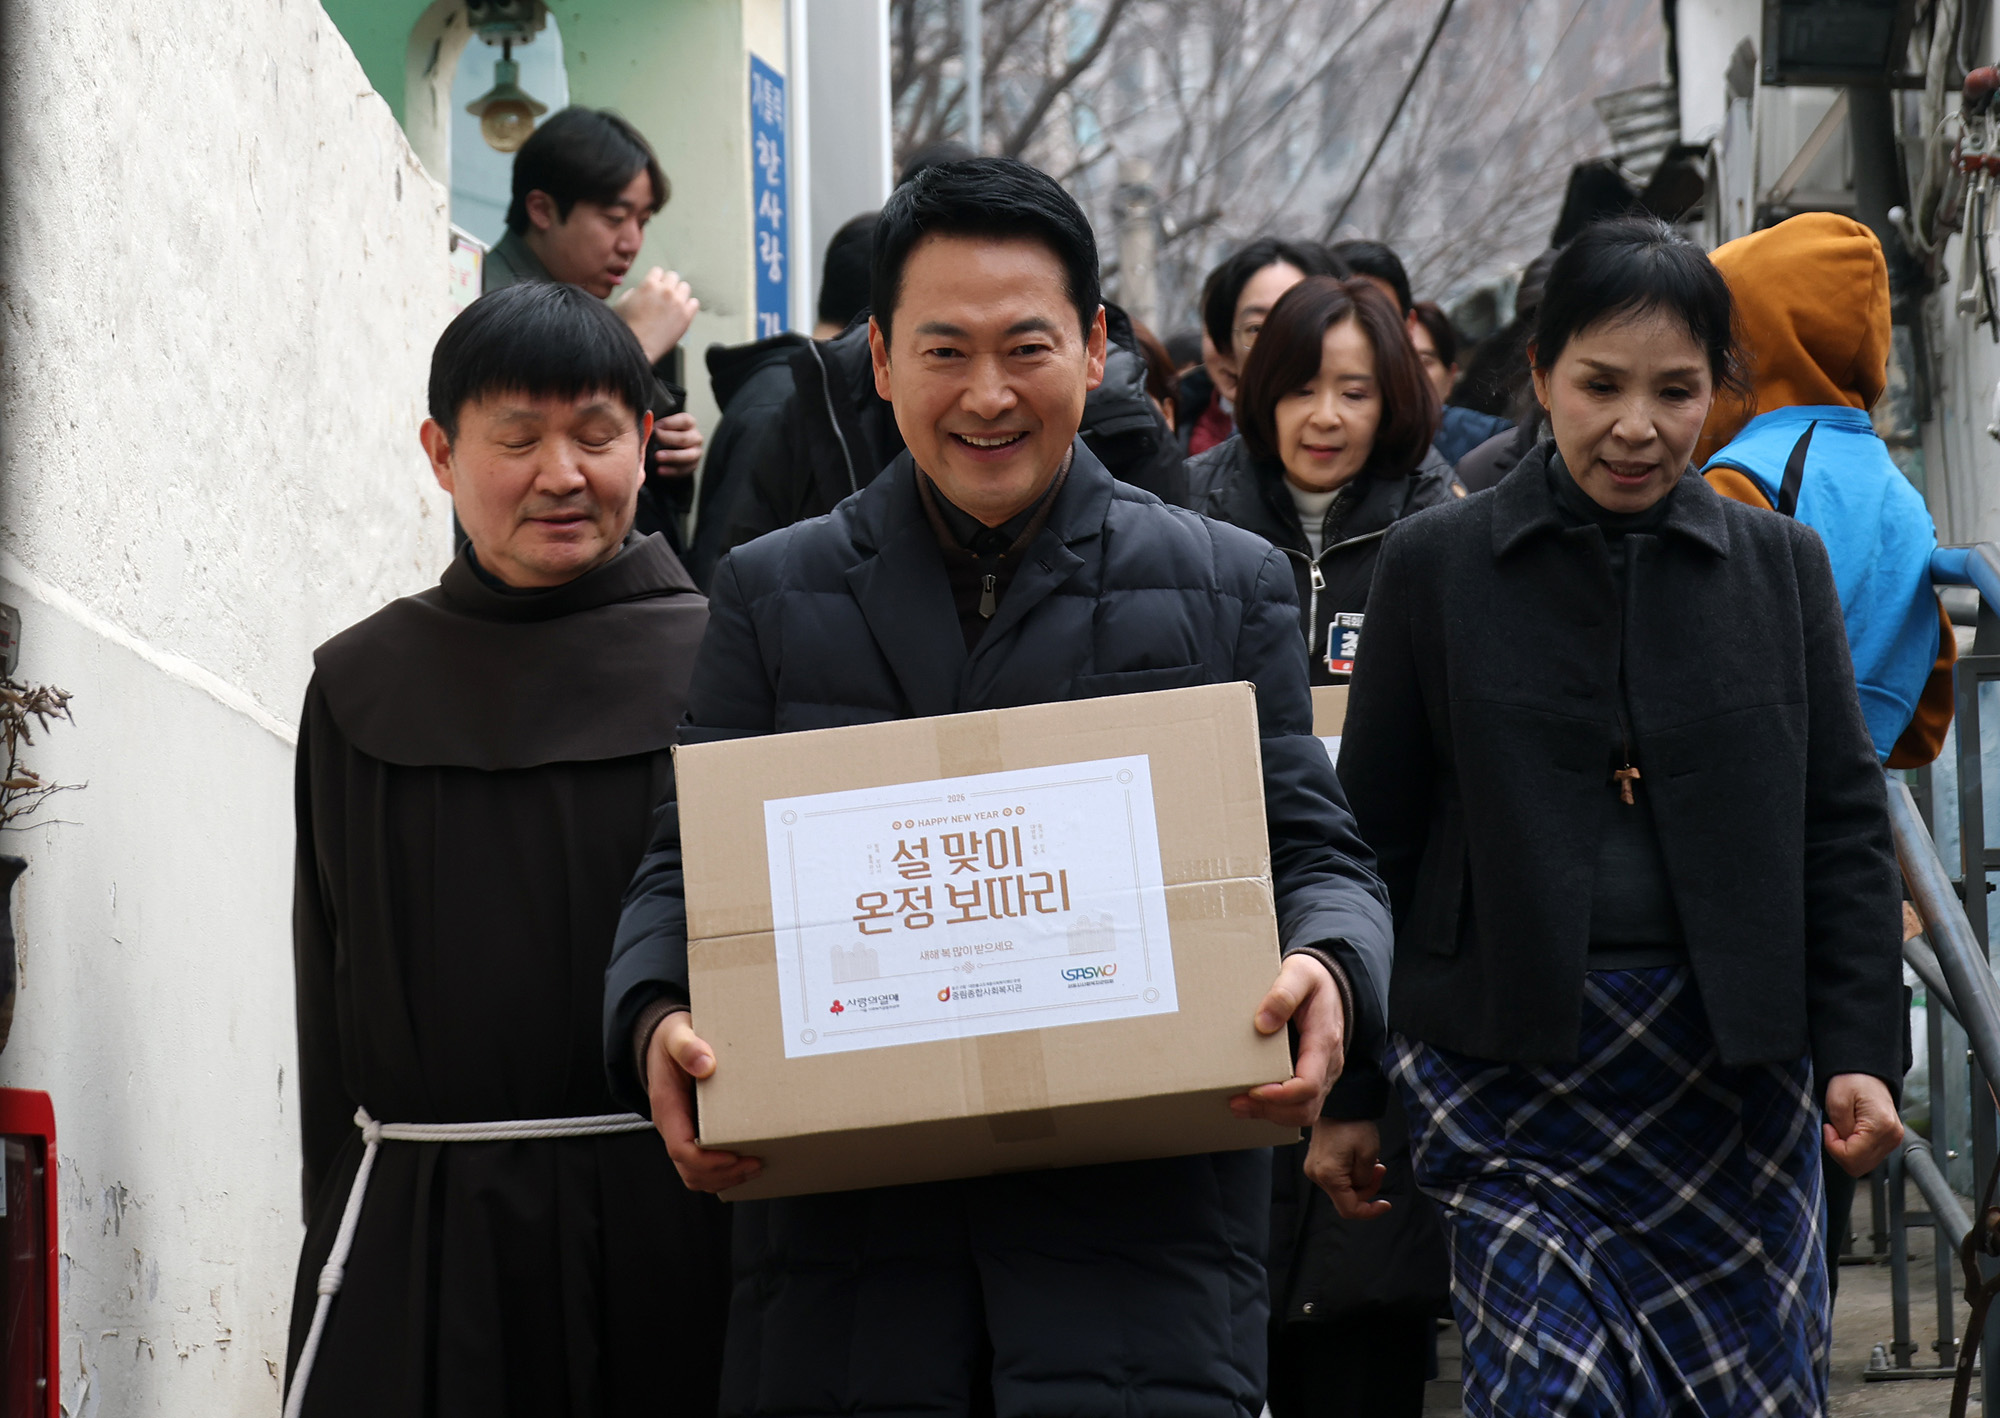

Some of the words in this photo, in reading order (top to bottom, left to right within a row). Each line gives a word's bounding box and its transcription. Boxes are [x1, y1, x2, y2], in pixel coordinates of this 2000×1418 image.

[756, 131, 784, 284] 한사랑
[947, 793, 966, 803] 2026
[918, 816, 949, 828] HAPPY
[951, 813, 972, 824] NEW
[974, 810, 999, 821] YEAR
[891, 836, 933, 880] 설
[939, 825, 1023, 876] 맞이
[852, 884, 934, 936] 온정
[944, 868, 1071, 925] 보따리
[920, 949, 939, 960] 새해
[941, 948, 951, 958] 복
[952, 945, 973, 958] 많이
[974, 940, 1014, 955] 받으세요
[846, 993, 900, 1008] 사랑의열매
[952, 984, 1023, 1000] 중림종합사회복지관
